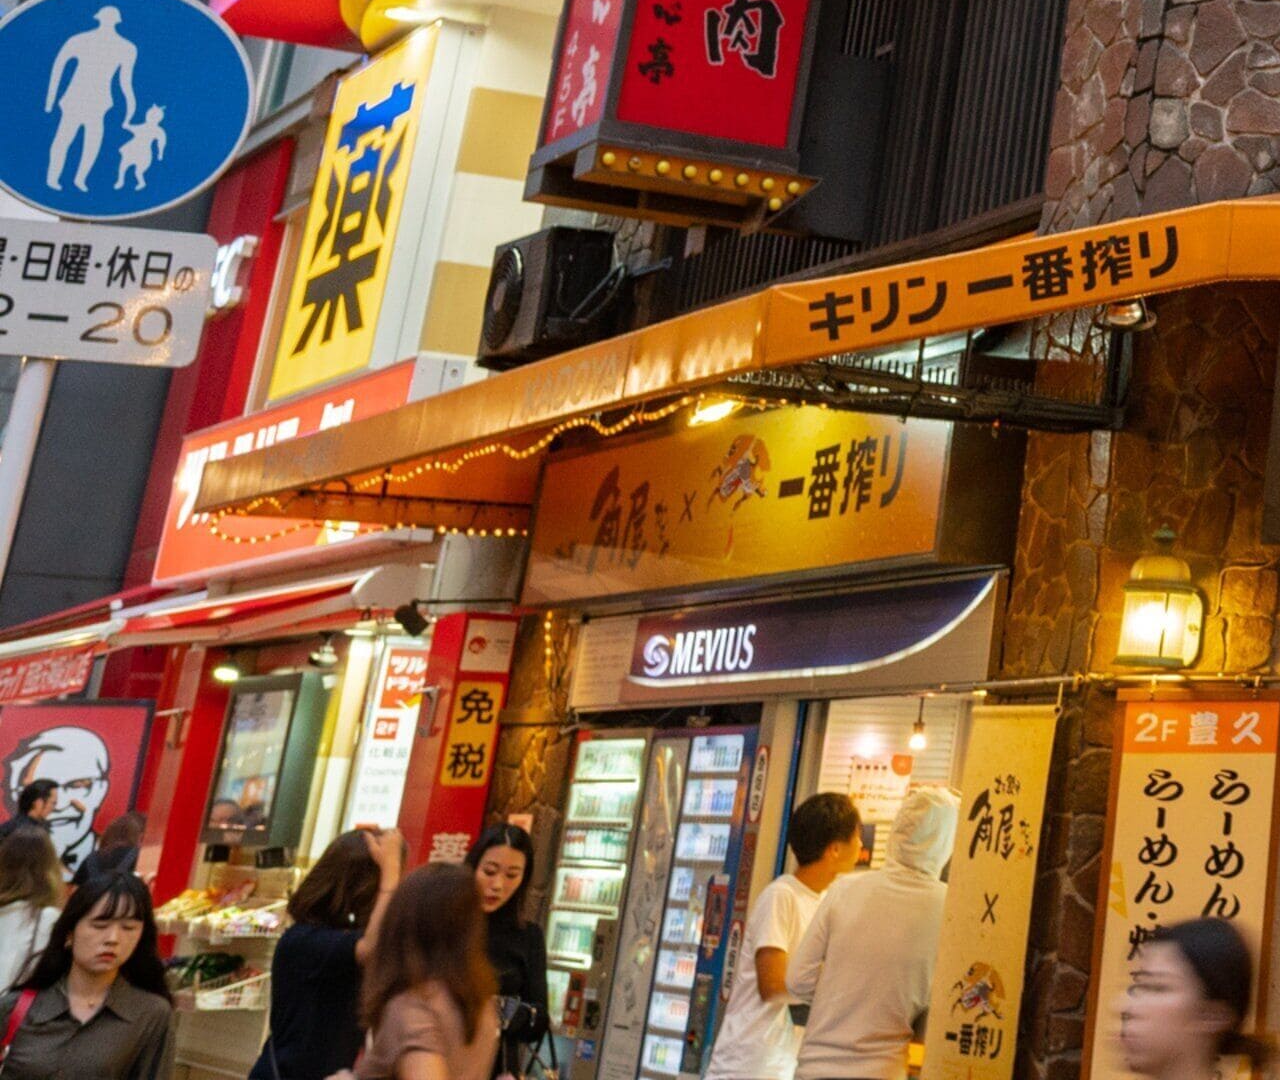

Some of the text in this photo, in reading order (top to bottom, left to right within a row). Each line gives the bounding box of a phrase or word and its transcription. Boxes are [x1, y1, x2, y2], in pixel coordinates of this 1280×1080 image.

[290, 81, 415, 359] 薬
[0, 237, 195, 293] ・日曜・休日の
[778, 433, 907, 520] 一番搾り
[670, 624, 757, 675] MEVIUS
[449, 688, 494, 779] 免税
[1134, 711, 1264, 747] 2F 豊久
[968, 789, 1015, 860] 角屋
[945, 1022, 1003, 1060] 一番搾り
